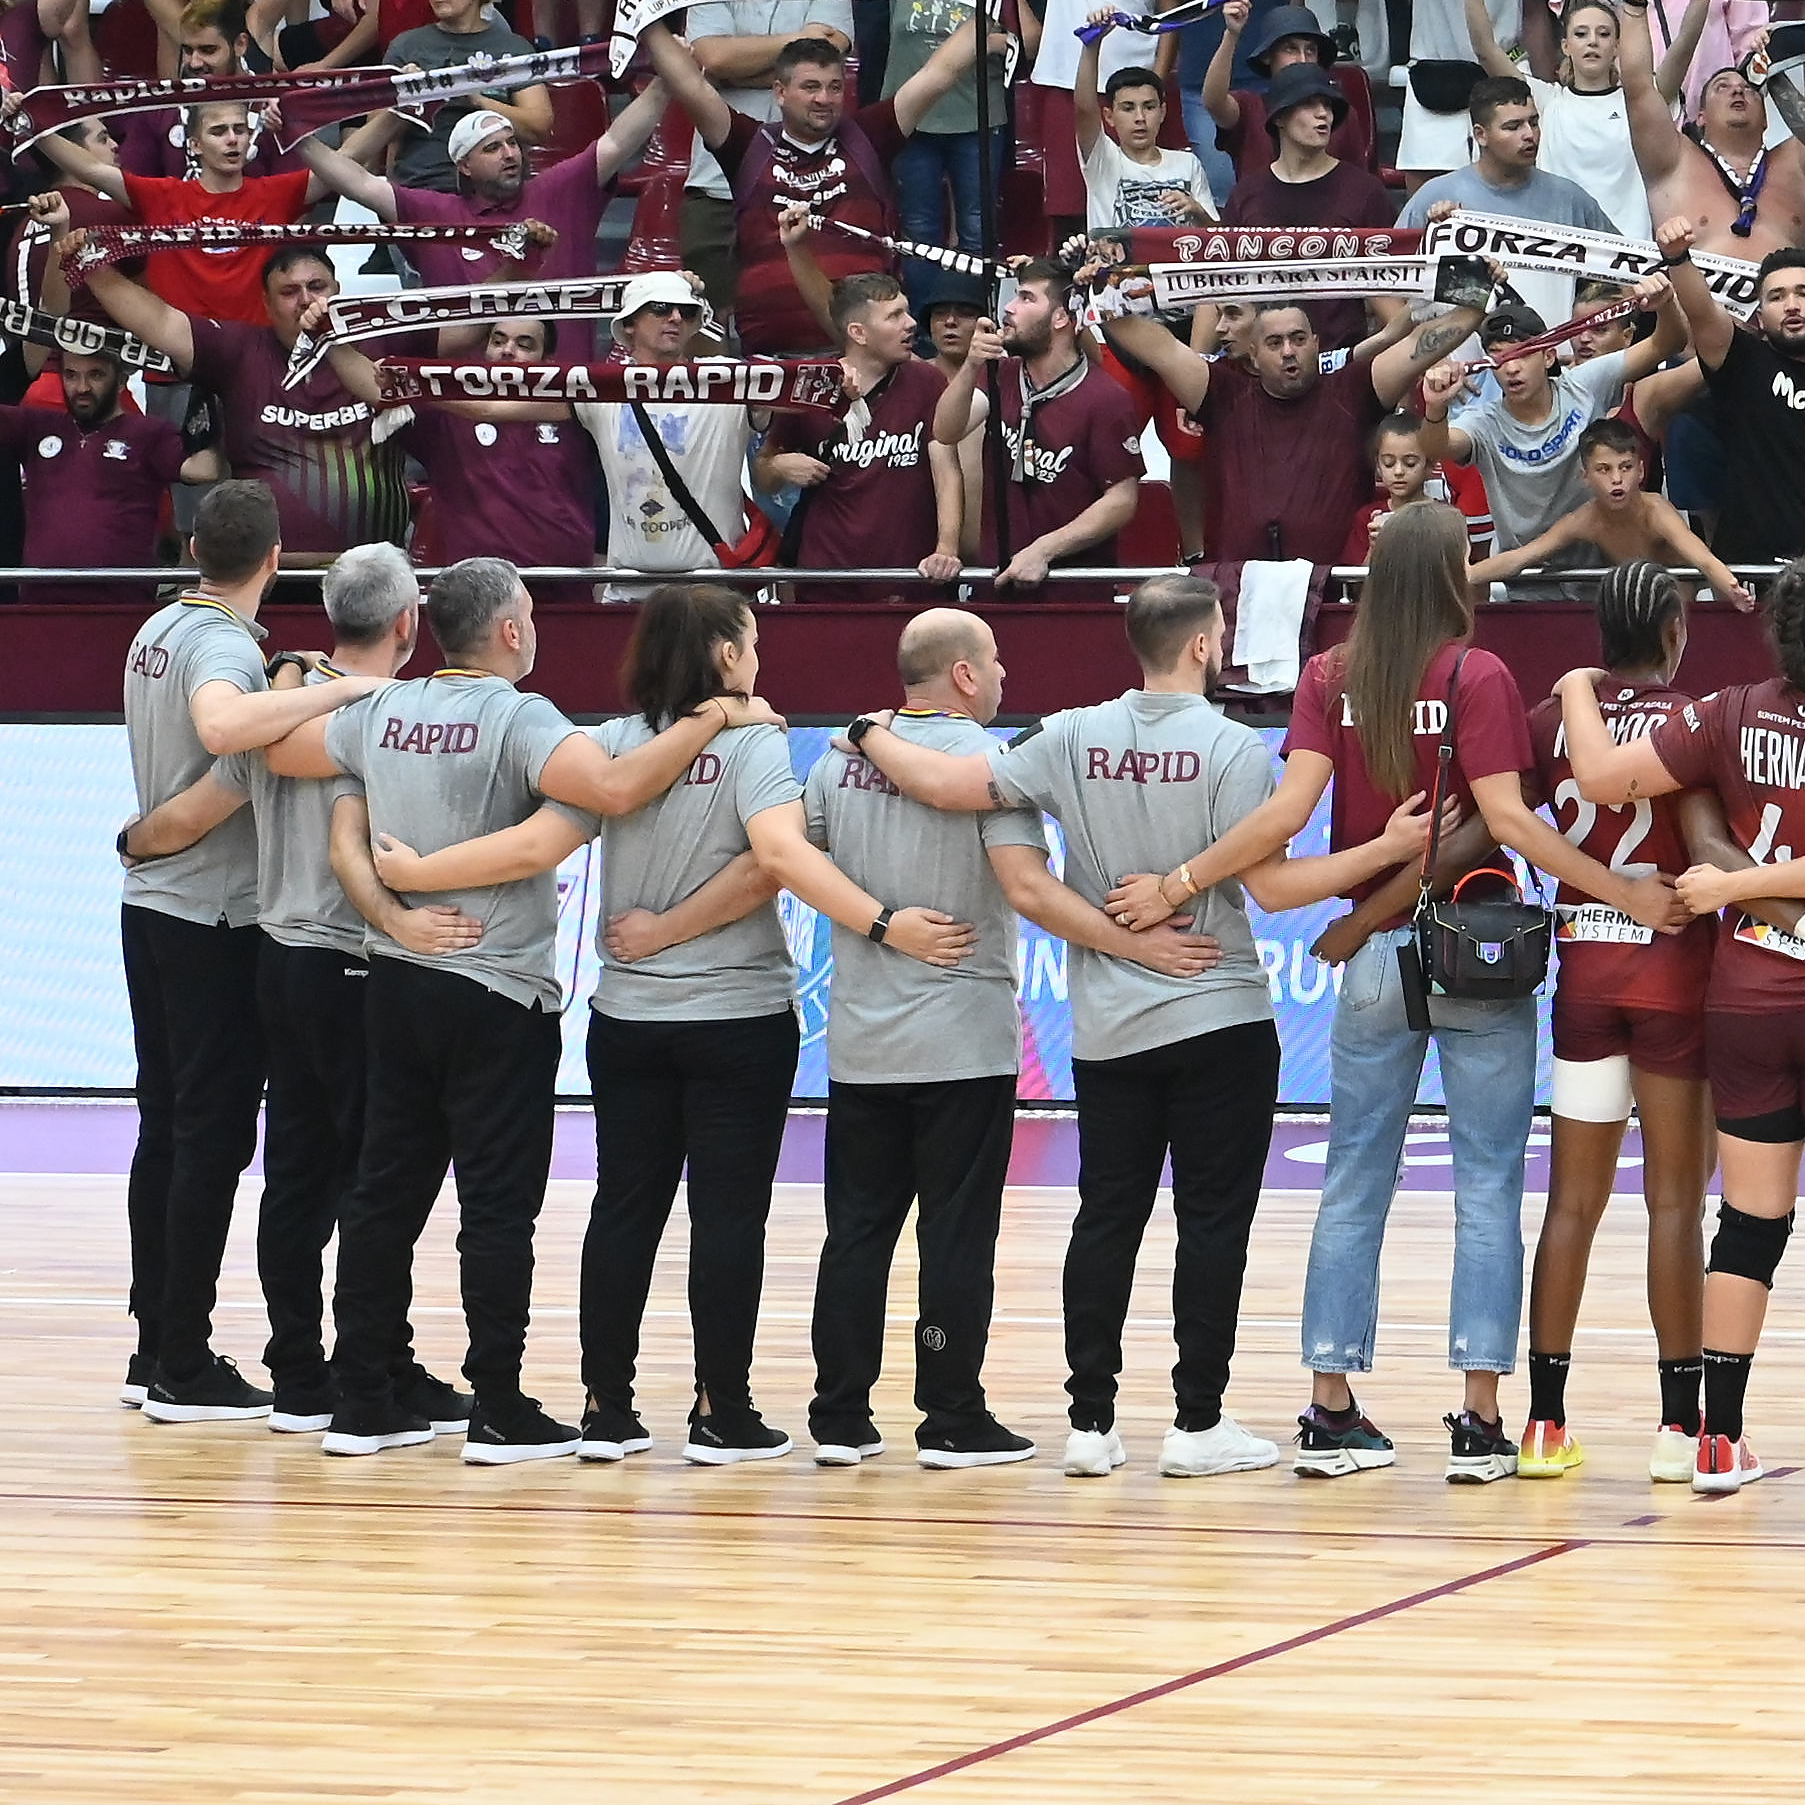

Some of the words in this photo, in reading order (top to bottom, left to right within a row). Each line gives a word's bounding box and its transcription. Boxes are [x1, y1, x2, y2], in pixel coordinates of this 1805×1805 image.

[64, 77, 174, 109] Rapid
[119, 225, 242, 245] RAPID
[1166, 272, 1250, 293] IUBIRE
[1427, 223, 1588, 264] FORZA
[1609, 250, 1759, 306] RAID
[328, 292, 451, 335] F.C.
[469, 282, 626, 315] RAPI
[625, 361, 781, 401] RAPID
[260, 402, 374, 432] SUPERBE
[832, 420, 924, 470] riginal
[887, 453, 918, 468] 1923
[378, 716, 479, 755] RAPID
[1087, 745, 1201, 785] RAPID
[1555, 779, 1658, 879] 22
